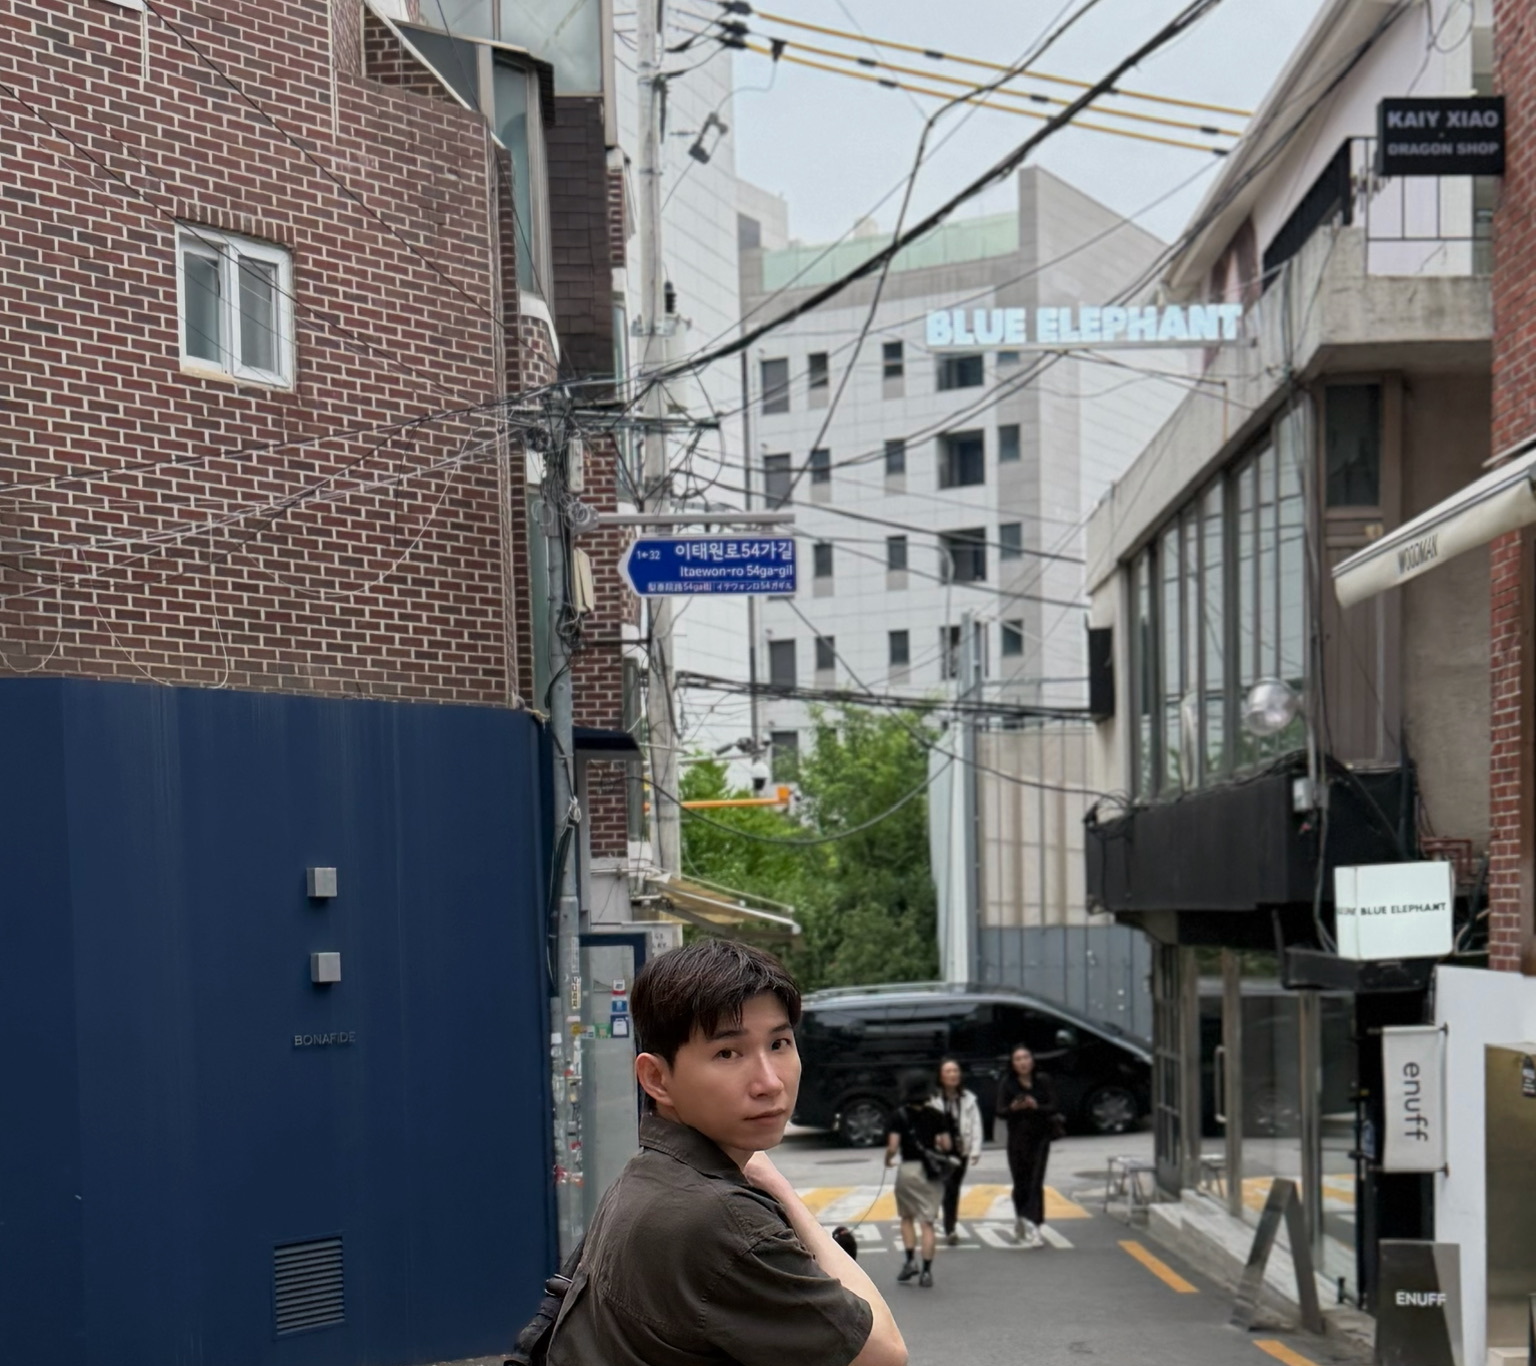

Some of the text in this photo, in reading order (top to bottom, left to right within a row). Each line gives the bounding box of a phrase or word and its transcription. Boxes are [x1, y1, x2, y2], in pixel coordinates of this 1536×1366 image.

[1387, 110, 1499, 128] KAIY XIAO
[1387, 142, 1499, 155] DRAGON SHOP
[926, 303, 1243, 345] BLUE ELEPHANT
[649, 551, 660, 560] 32
[675, 541, 792, 561] 이태원로54가길
[680, 565, 792, 578] Itaewon-ro 54ga-gil
[1360, 905, 1387, 916] BLUE
[1391, 902, 1446, 914] ELEPHANT
[294, 1031, 356, 1046] BONAFIDE
[1403, 1062, 1428, 1142] enuff
[1395, 1292, 1446, 1306] ENUFF
